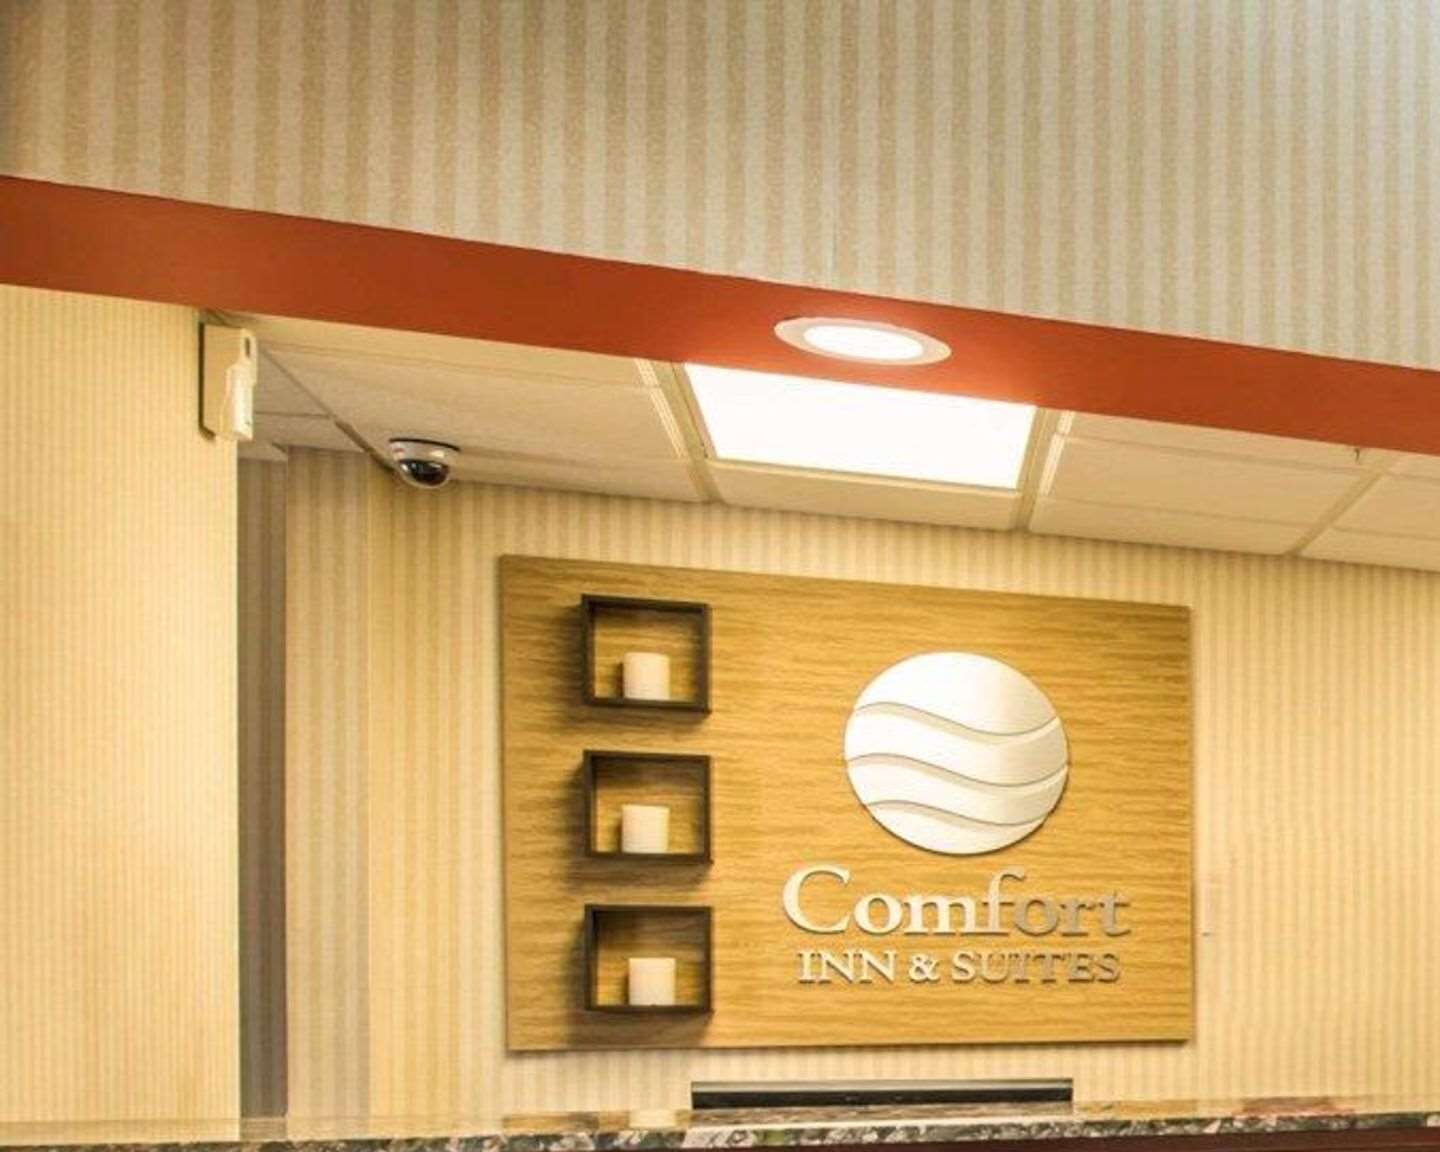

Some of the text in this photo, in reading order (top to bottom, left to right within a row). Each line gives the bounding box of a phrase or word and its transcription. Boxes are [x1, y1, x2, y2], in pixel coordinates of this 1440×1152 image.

[782, 863, 1132, 936] Comfort
[797, 947, 1122, 985] INN & SUITES
